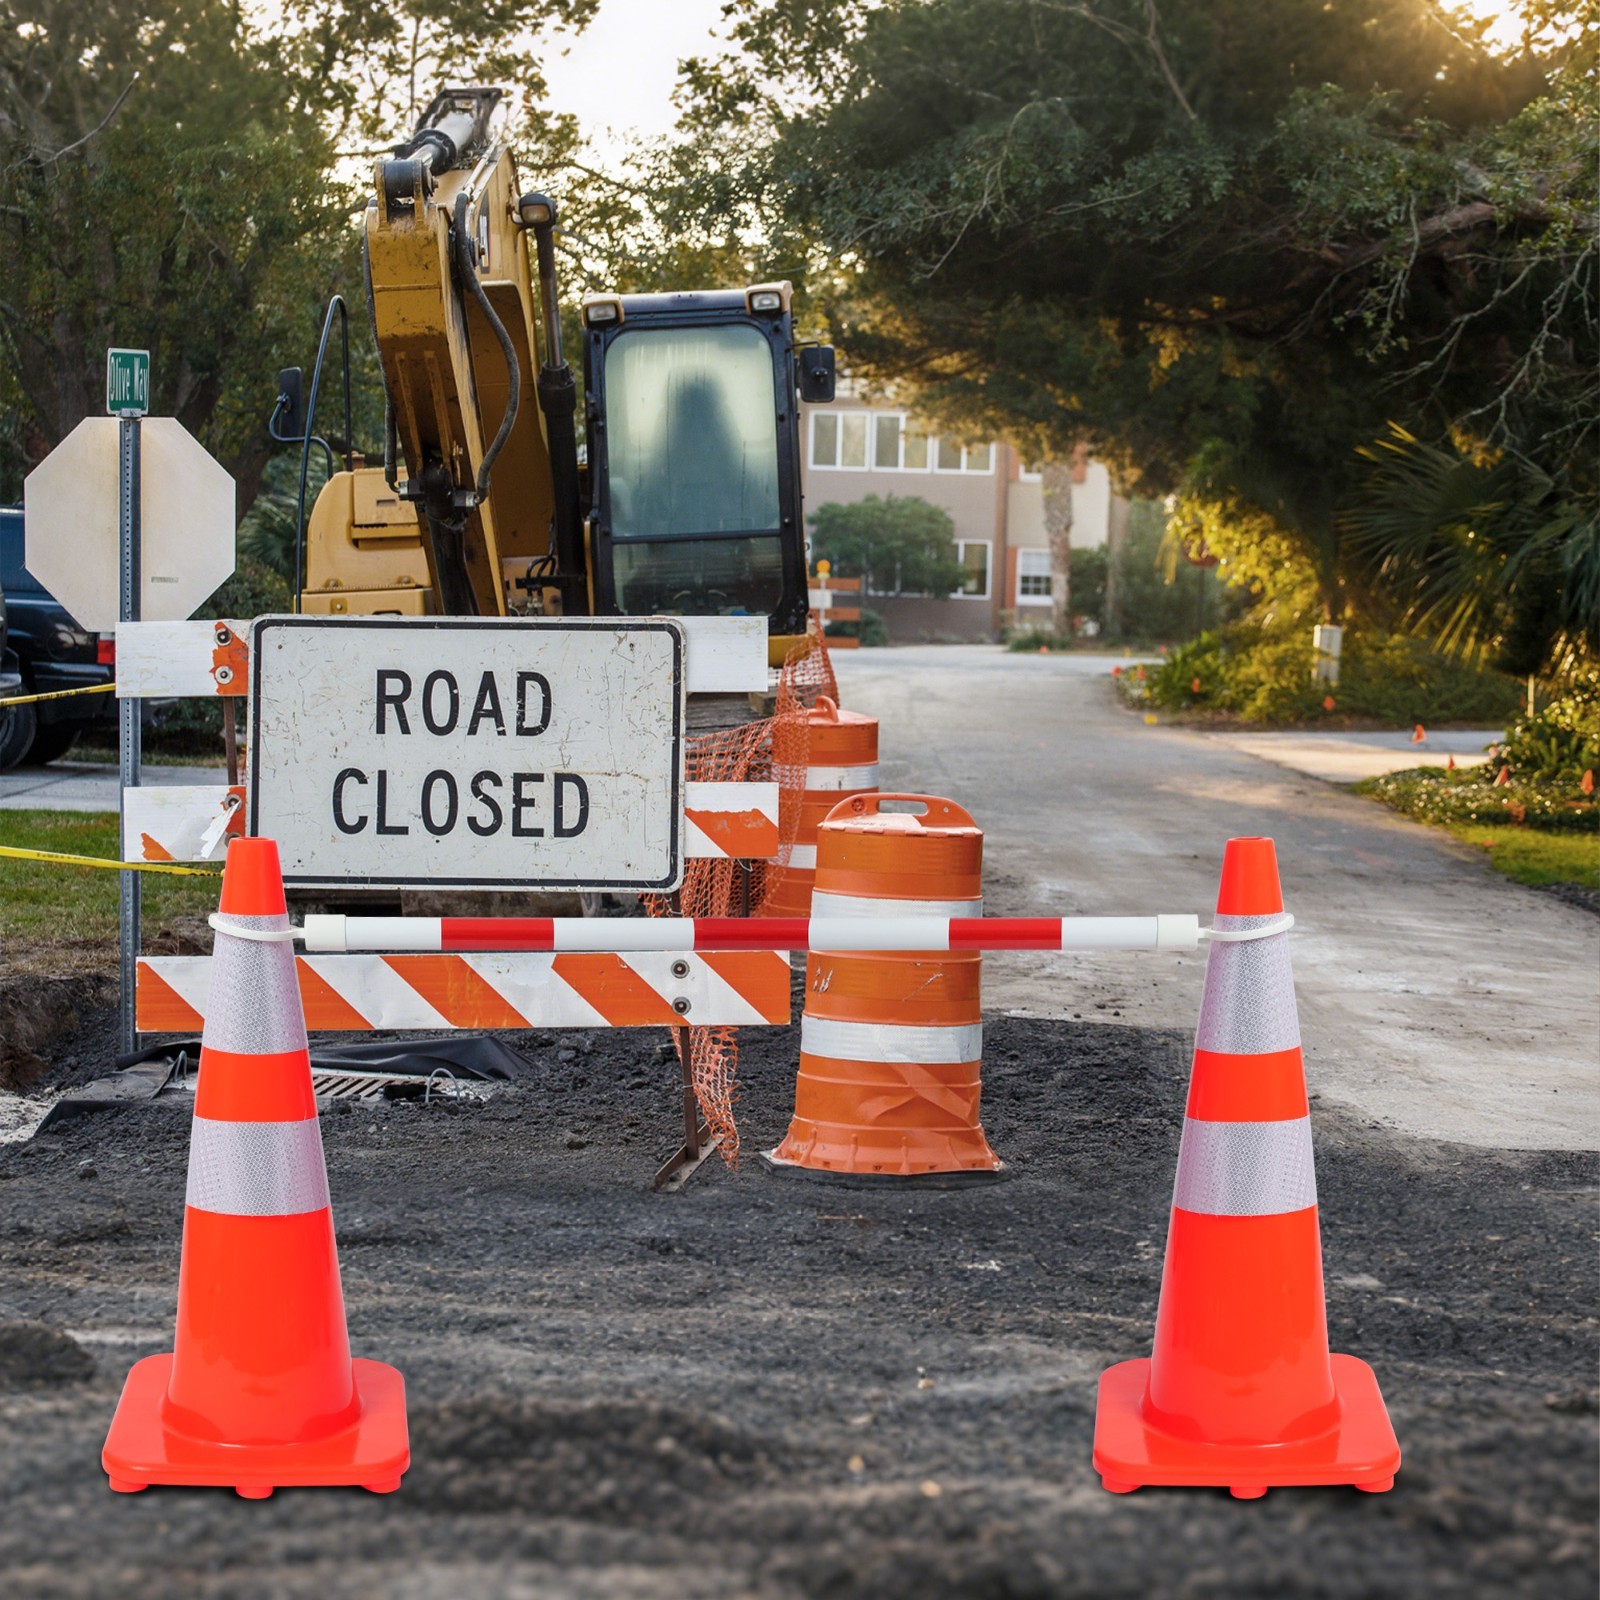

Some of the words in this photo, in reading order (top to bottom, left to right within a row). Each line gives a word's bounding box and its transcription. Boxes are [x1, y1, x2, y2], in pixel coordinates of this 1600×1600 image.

[110, 356, 131, 401] Olive
[135, 357, 148, 407] Way
[376, 669, 552, 737] ROAD
[332, 767, 590, 838] CLOSED
